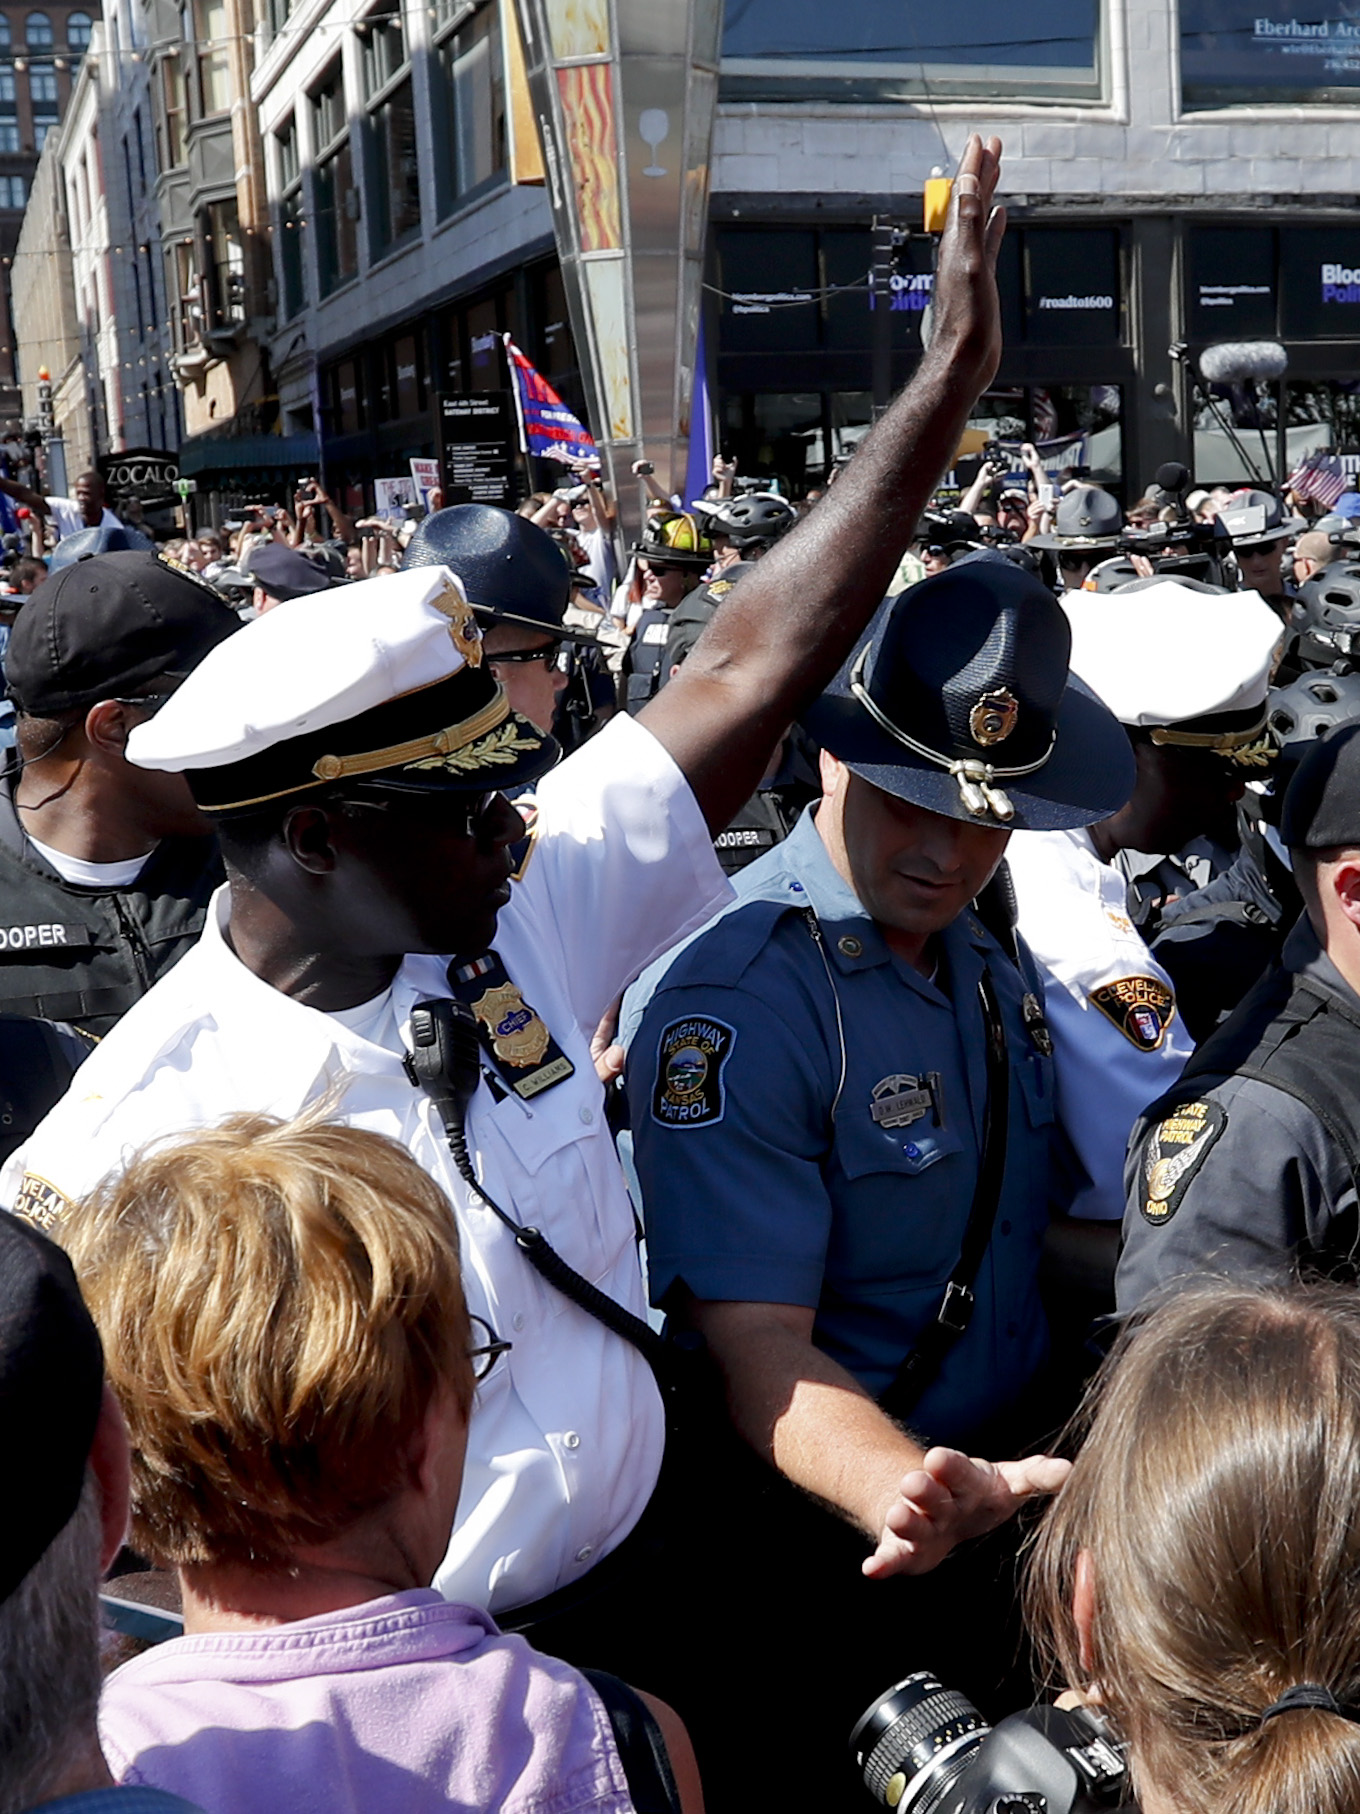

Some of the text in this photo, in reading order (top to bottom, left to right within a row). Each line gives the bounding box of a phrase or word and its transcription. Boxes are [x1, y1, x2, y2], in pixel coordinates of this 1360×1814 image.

[1254, 18, 1329, 37] Eberhard
[1039, 294, 1113, 310] #roadto1600
[106, 463, 179, 485] ZOCALO
[0, 923, 67, 950] OOPER
[1115, 989, 1167, 1009] POLICE
[502, 1011, 530, 1032] CHIEF
[663, 1022, 726, 1054] HIGHWAY
[668, 1036, 716, 1056] STATE OF
[531, 1062, 568, 1086] WILLIAMS
[663, 1088, 705, 1106] KANSAS
[660, 1095, 711, 1121] PATROL
[1161, 1118, 1207, 1132] HIGHWAY
[1159, 1130, 1195, 1145] PATROL
[14, 1193, 56, 1230] OLICE
[1146, 1199, 1168, 1216] OHIO
